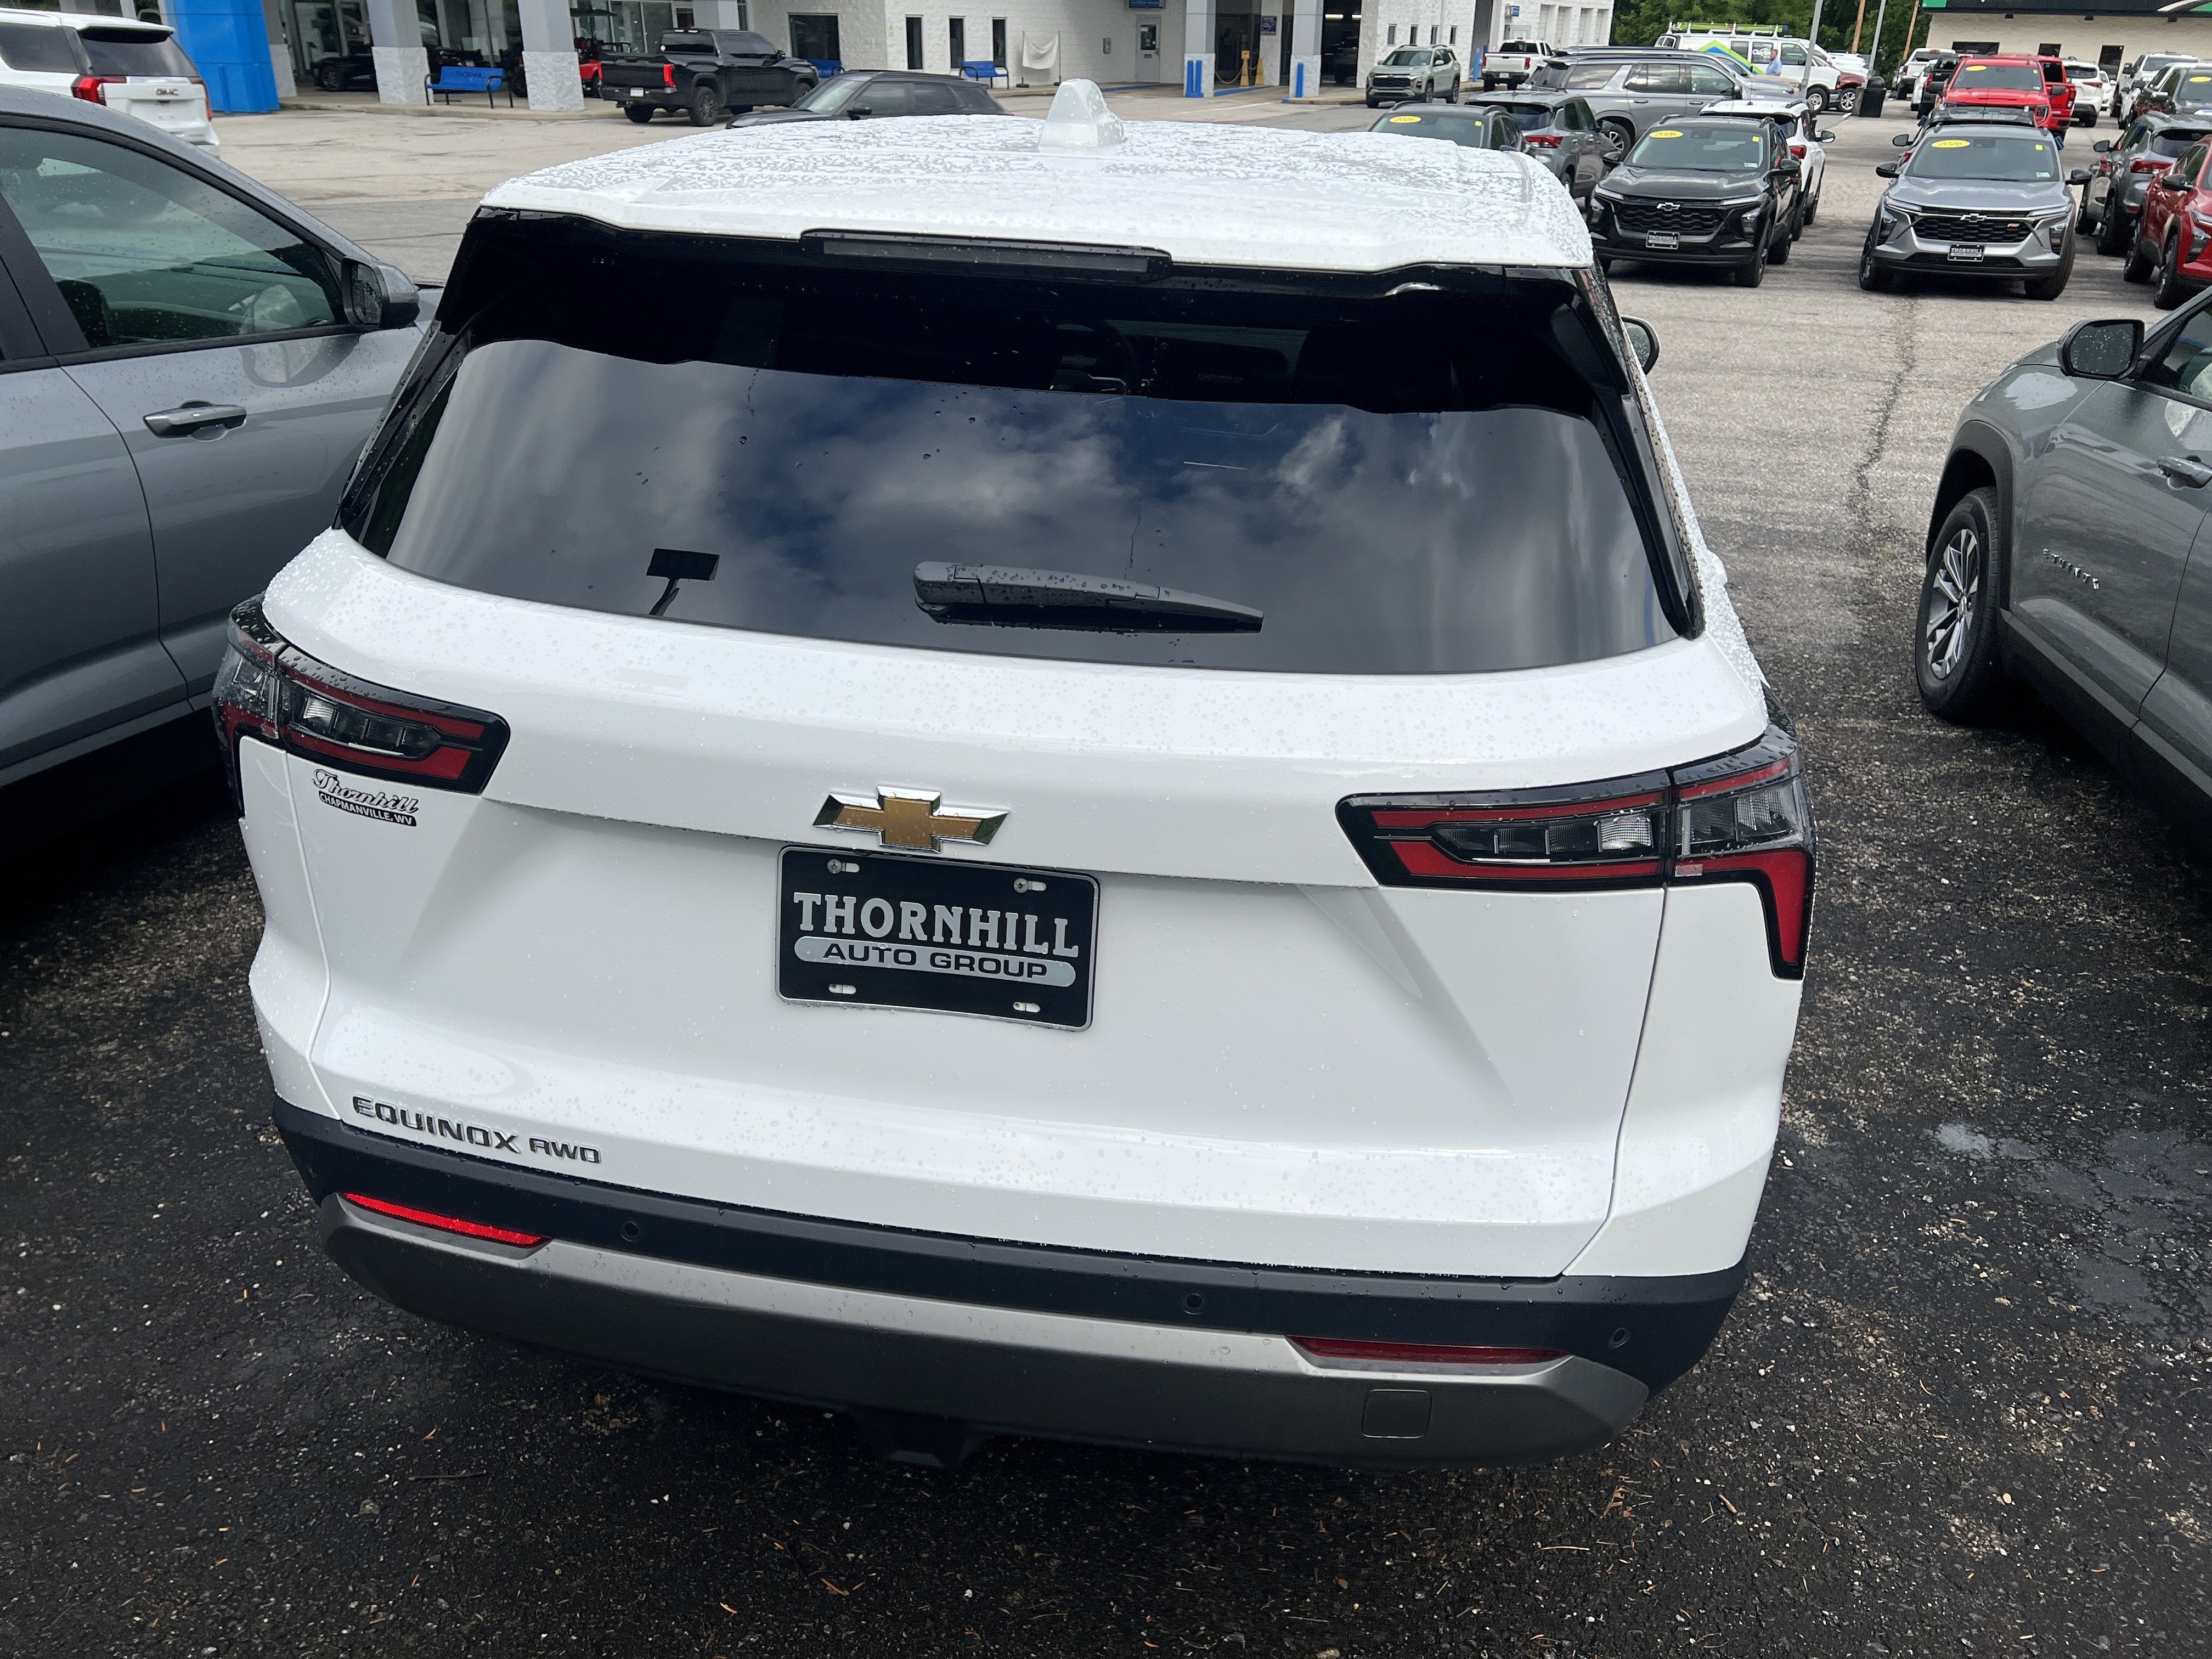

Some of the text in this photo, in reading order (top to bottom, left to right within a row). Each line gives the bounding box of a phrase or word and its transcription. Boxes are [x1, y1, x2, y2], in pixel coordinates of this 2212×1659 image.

[155, 88, 178, 96] GMC
[312, 769, 419, 813] Thornhill
[320, 793, 412, 825] CHAPMANVILLE, WV
[793, 892, 1079, 958] THORNHILL
[823, 943, 1047, 979] AUTO GROUP
[353, 1095, 601, 1164] EQUINOX AWD
